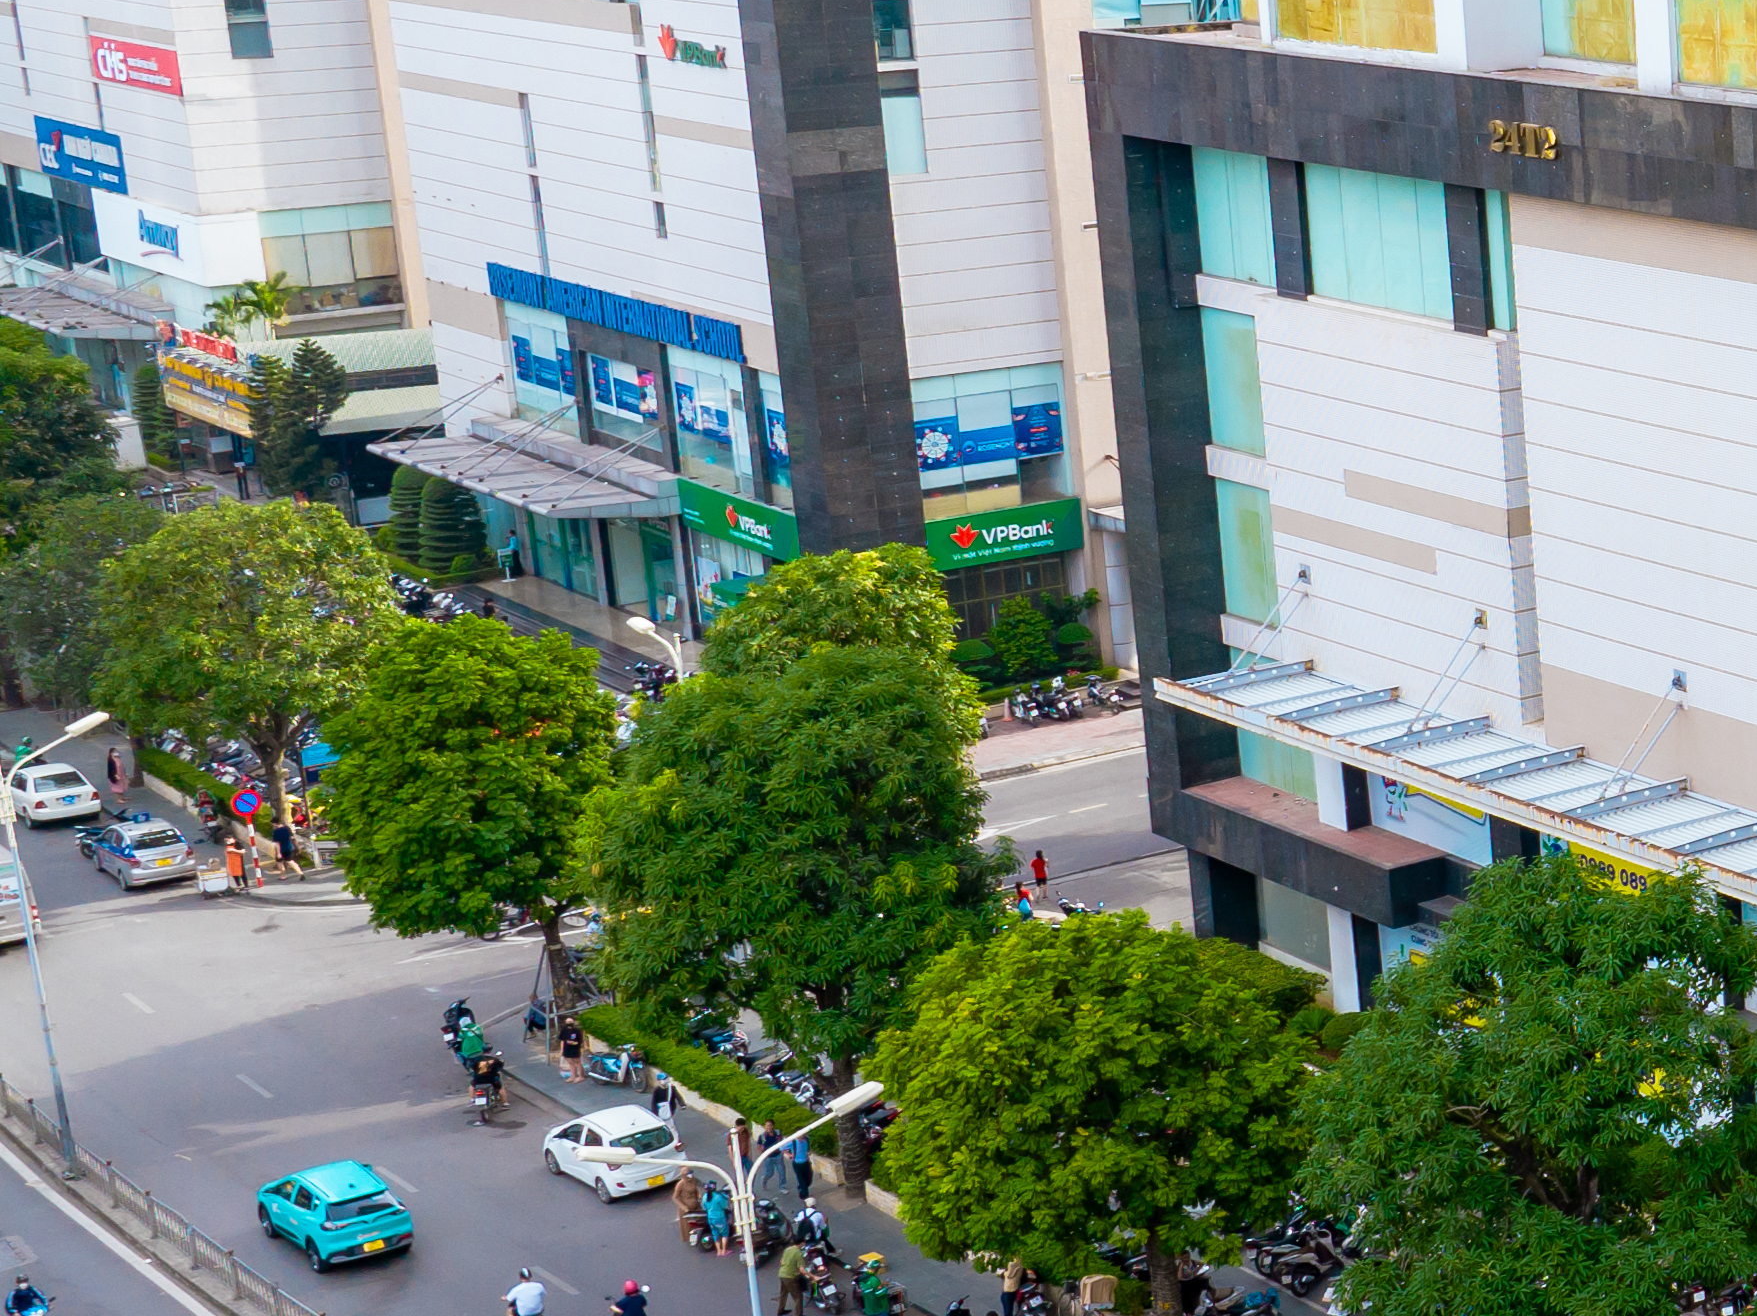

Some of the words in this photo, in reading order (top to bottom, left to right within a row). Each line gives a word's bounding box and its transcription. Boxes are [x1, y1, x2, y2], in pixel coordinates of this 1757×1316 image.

[1488, 119, 1557, 160] 24T2
[546, 275, 600, 324] AMERICAN
[601, 289, 694, 347] INTERNATIONAL
[693, 314, 745, 364] SCHOOL
[738, 515, 772, 540] VPBank
[982, 519, 1054, 545] VPBank
[1620, 868, 1648, 892] 089
